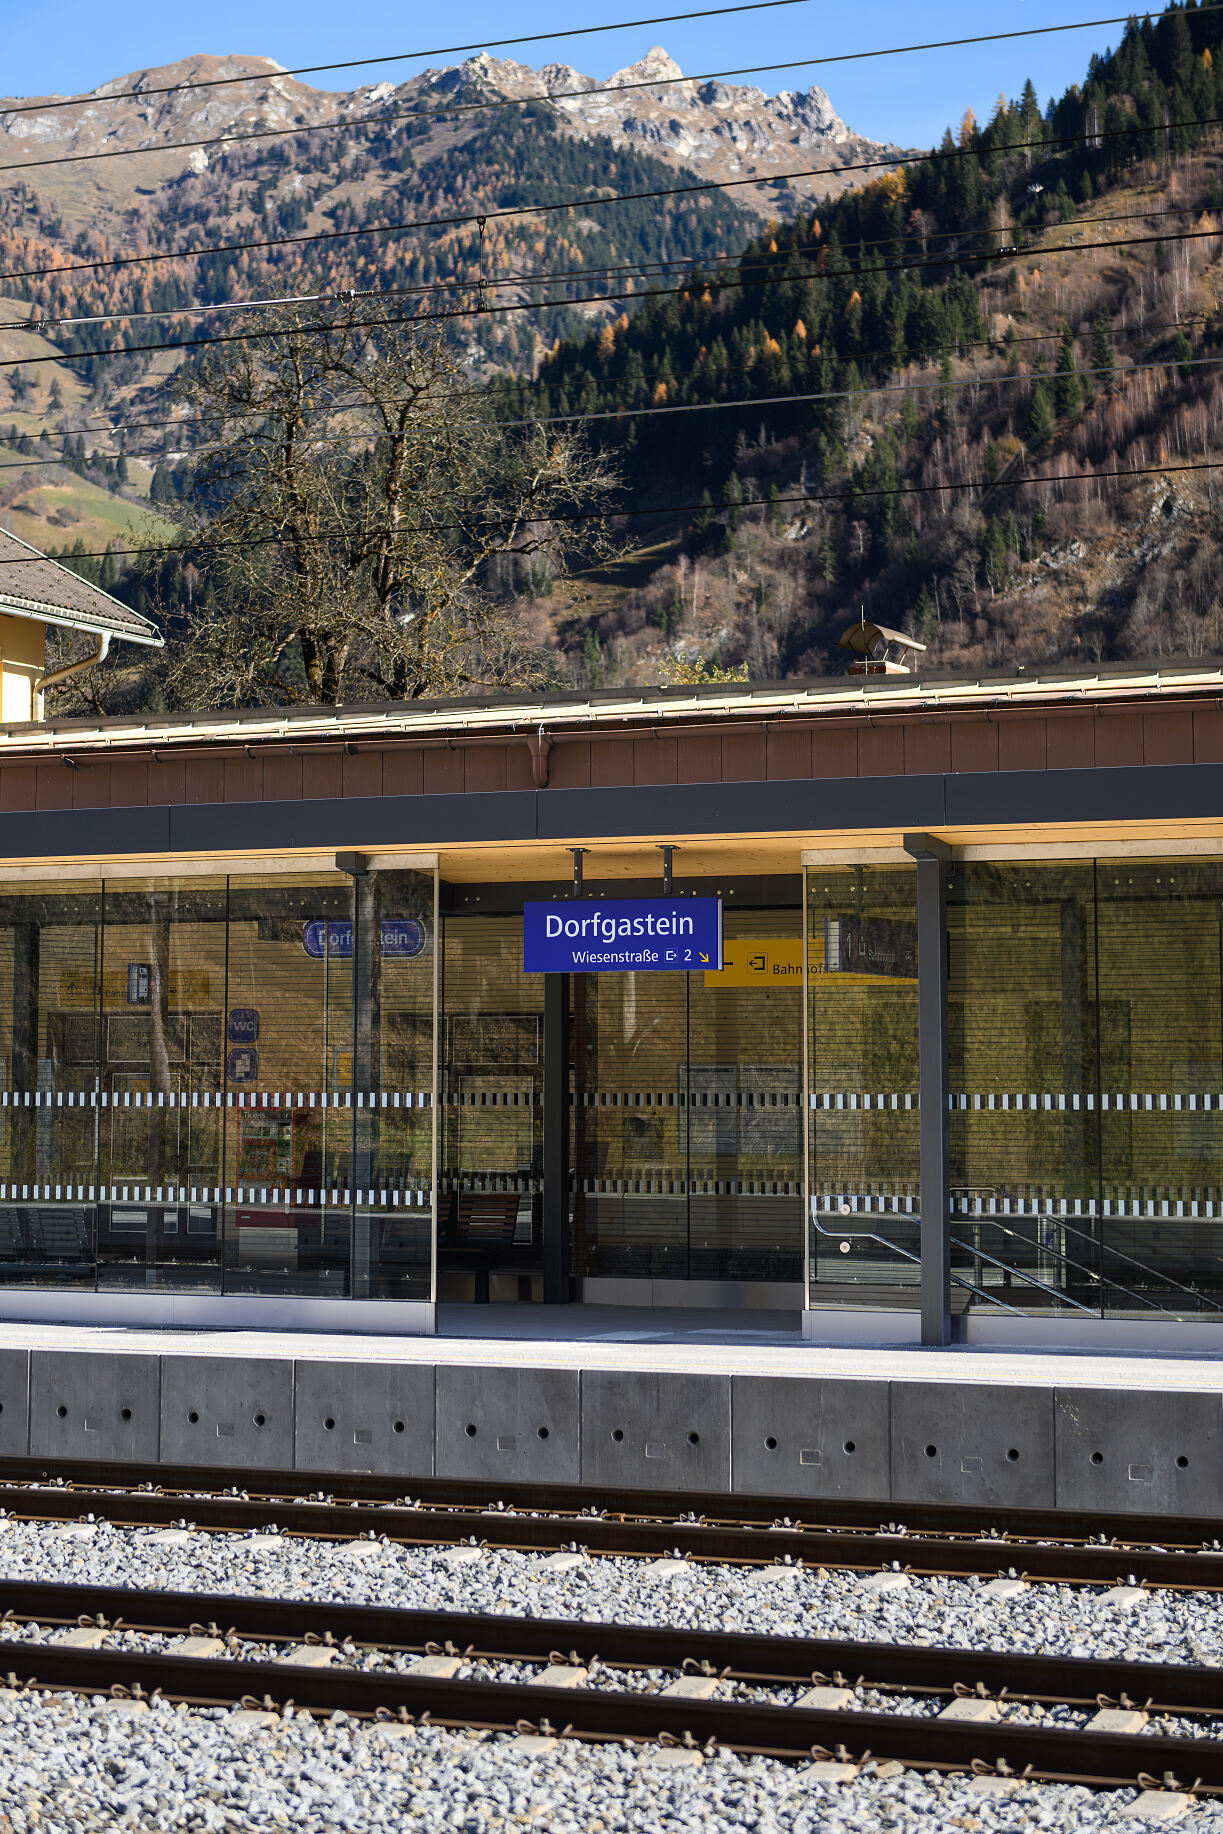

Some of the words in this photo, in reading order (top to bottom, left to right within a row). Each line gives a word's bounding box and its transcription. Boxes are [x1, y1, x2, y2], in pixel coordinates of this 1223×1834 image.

[546, 911, 694, 944] Dorfgastein
[318, 929, 408, 946] Dorftein
[572, 949, 659, 964] Wiesenstraße
[684, 949, 692, 962] 2
[233, 1021, 254, 1031] WC
